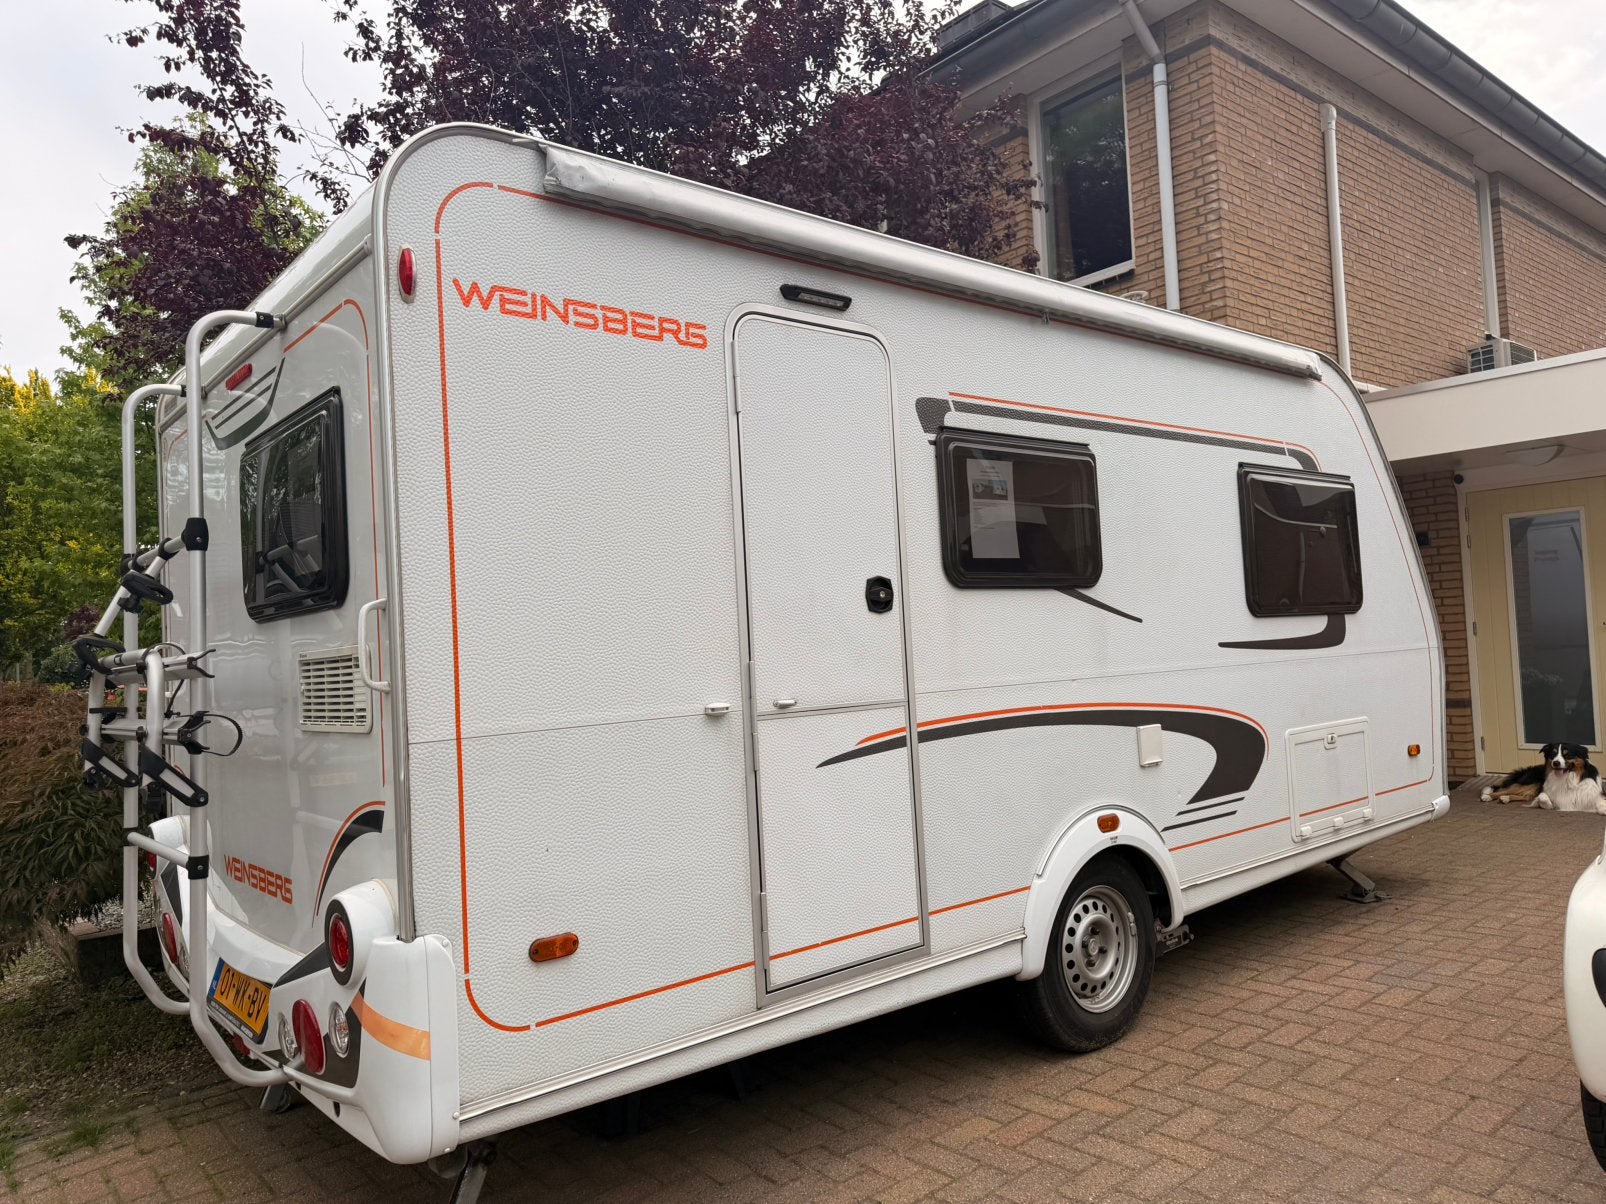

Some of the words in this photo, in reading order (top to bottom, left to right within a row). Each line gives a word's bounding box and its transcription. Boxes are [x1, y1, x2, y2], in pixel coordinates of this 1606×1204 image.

[452, 277, 708, 350] WEINSBERG
[223, 854, 293, 905] WEINSBERG
[220, 967, 267, 1023] 01-WK-BV
